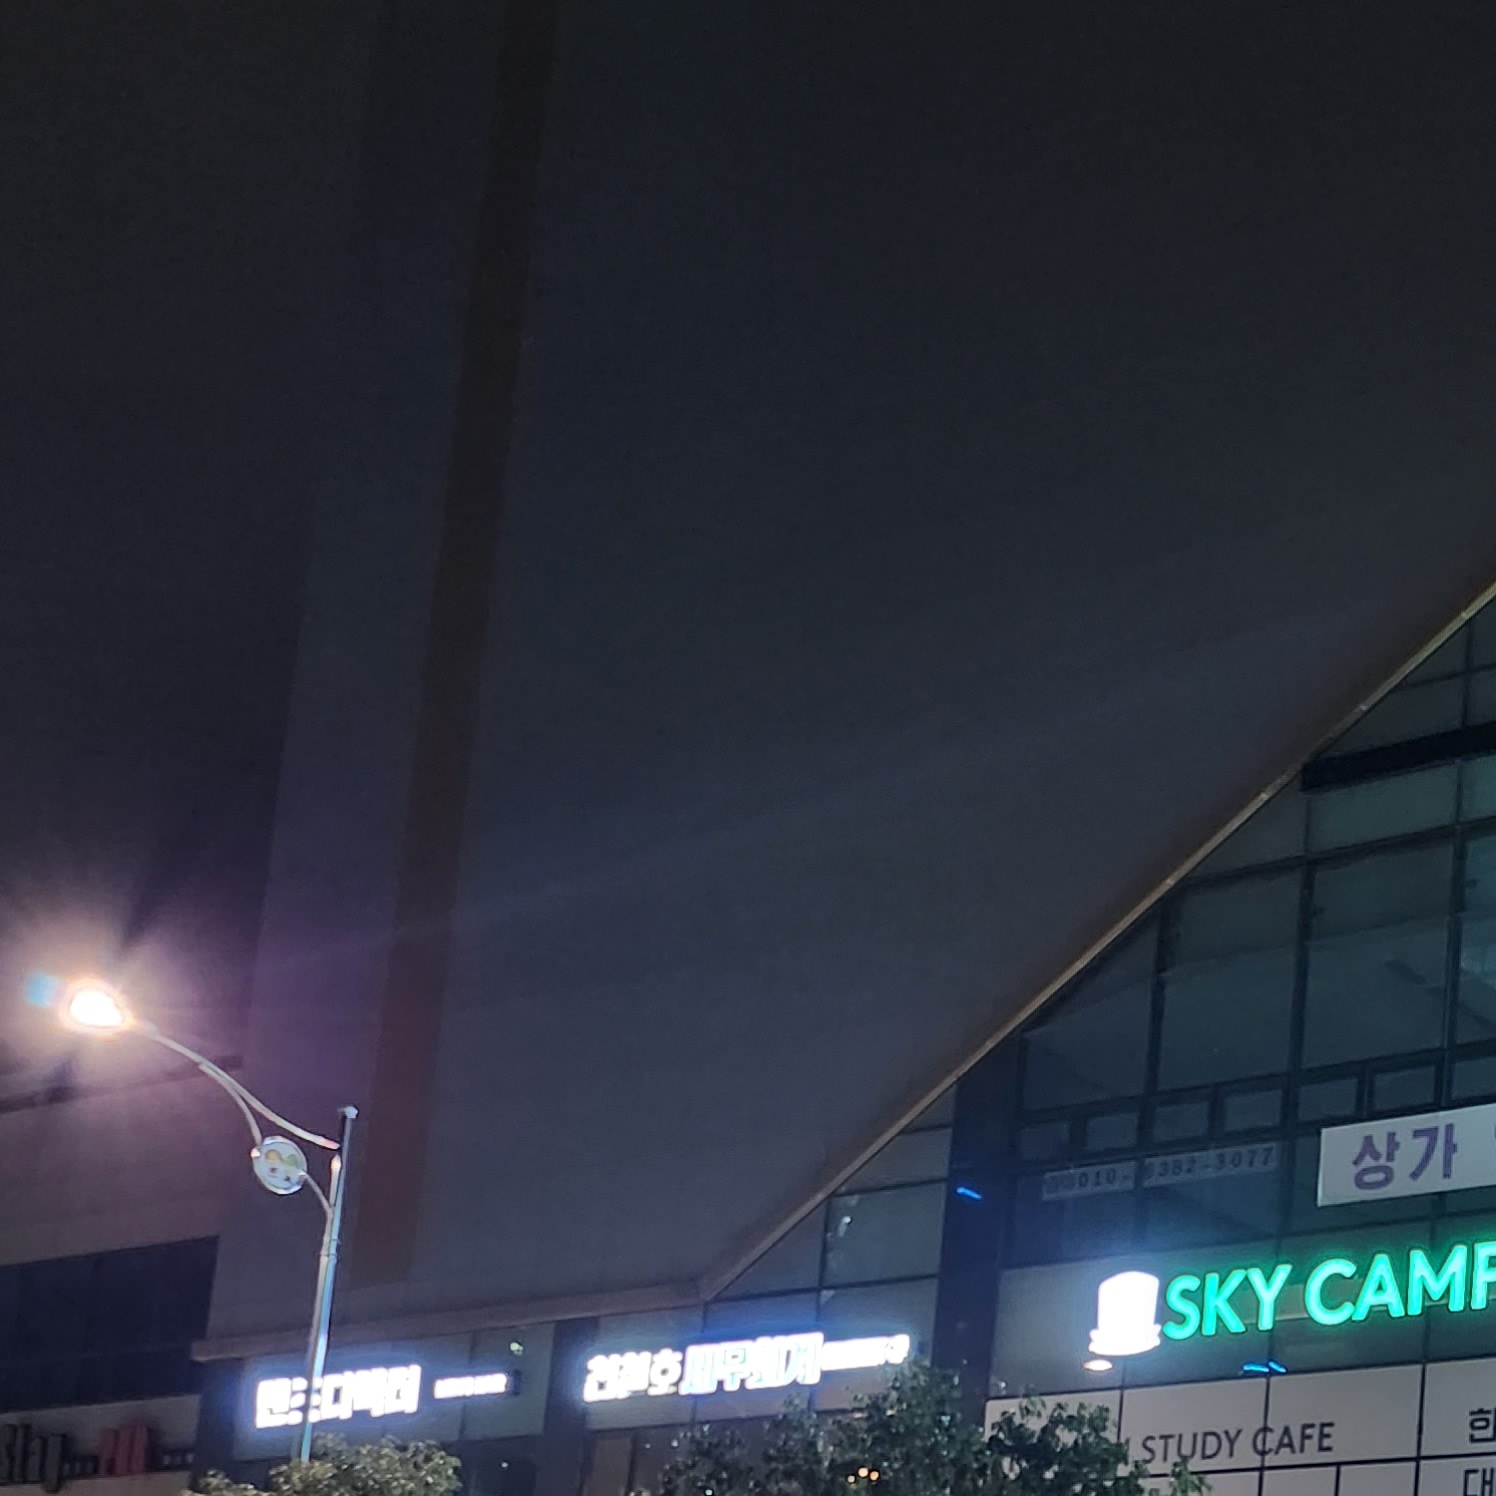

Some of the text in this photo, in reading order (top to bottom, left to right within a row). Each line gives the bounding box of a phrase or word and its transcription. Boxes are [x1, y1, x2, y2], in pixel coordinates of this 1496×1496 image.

[1351, 1122, 1457, 1191] 상가
[1163, 1264, 1293, 1341] SKY
[1141, 1422, 1335, 1464] STUDY CAFE
